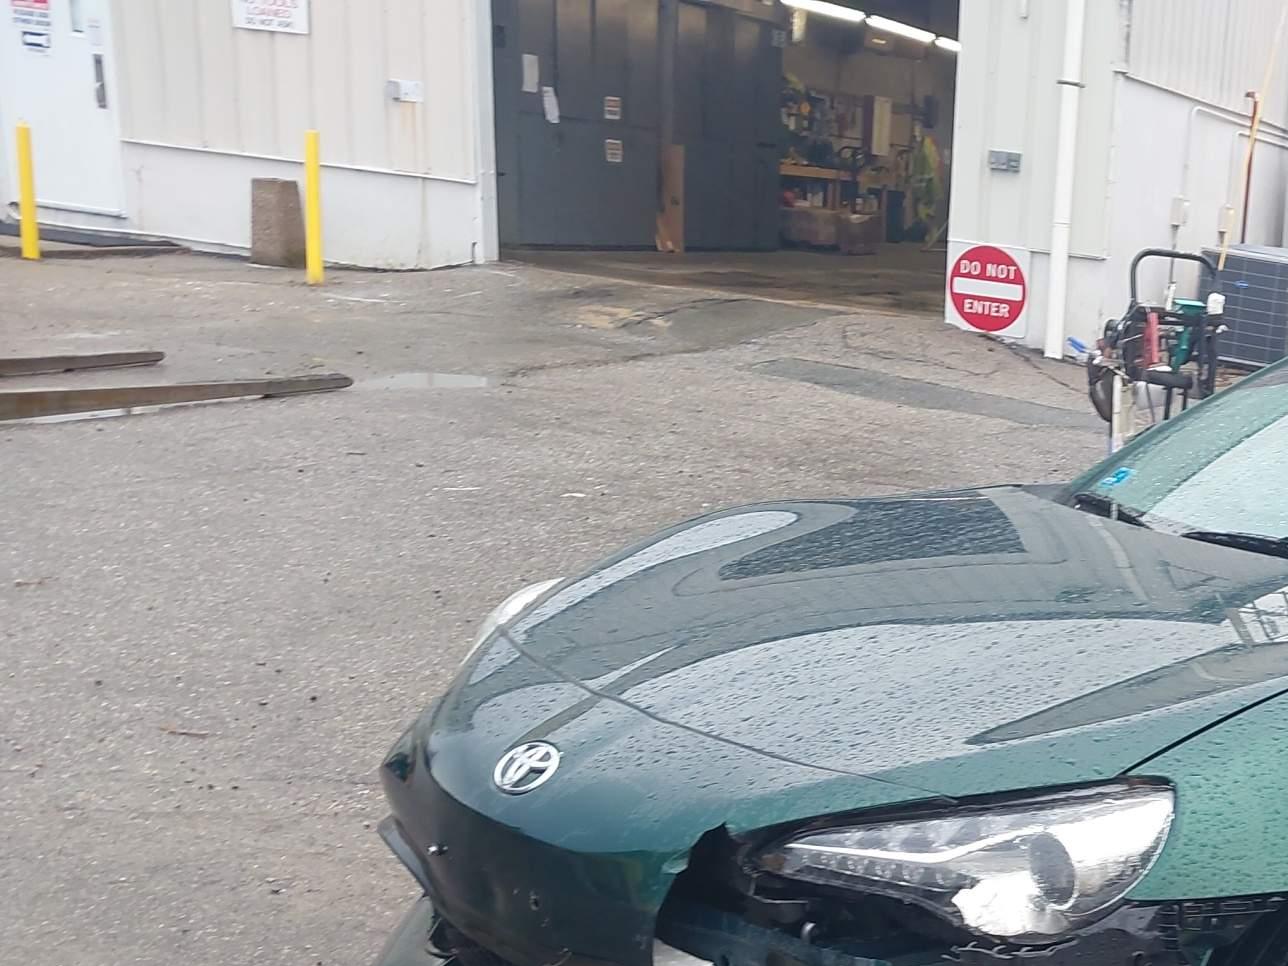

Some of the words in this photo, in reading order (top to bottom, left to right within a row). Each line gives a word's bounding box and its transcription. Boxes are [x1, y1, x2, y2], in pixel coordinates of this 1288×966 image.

[960, 259, 981, 275] DO
[986, 263, 1017, 280] NOT
[963, 298, 1010, 318] ENTER
